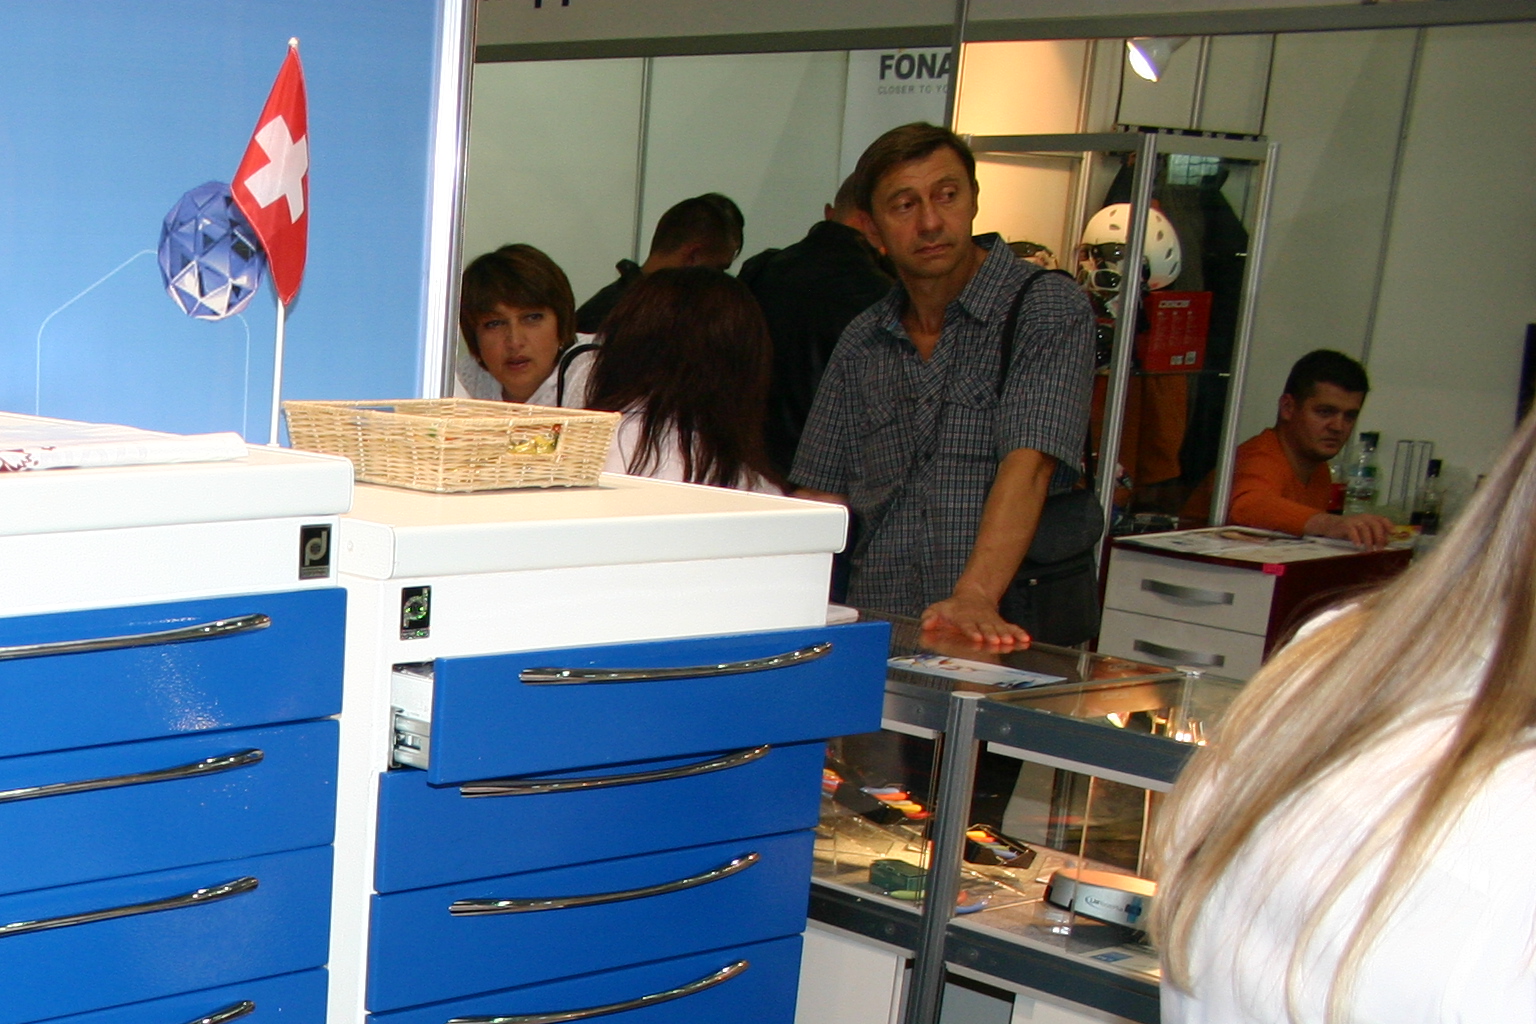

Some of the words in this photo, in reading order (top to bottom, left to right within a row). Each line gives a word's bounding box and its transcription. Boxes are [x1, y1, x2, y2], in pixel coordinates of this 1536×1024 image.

[880, 53, 951, 80] FONA
[878, 85, 914, 95] CLOSER
[920, 85, 932, 94] TO
